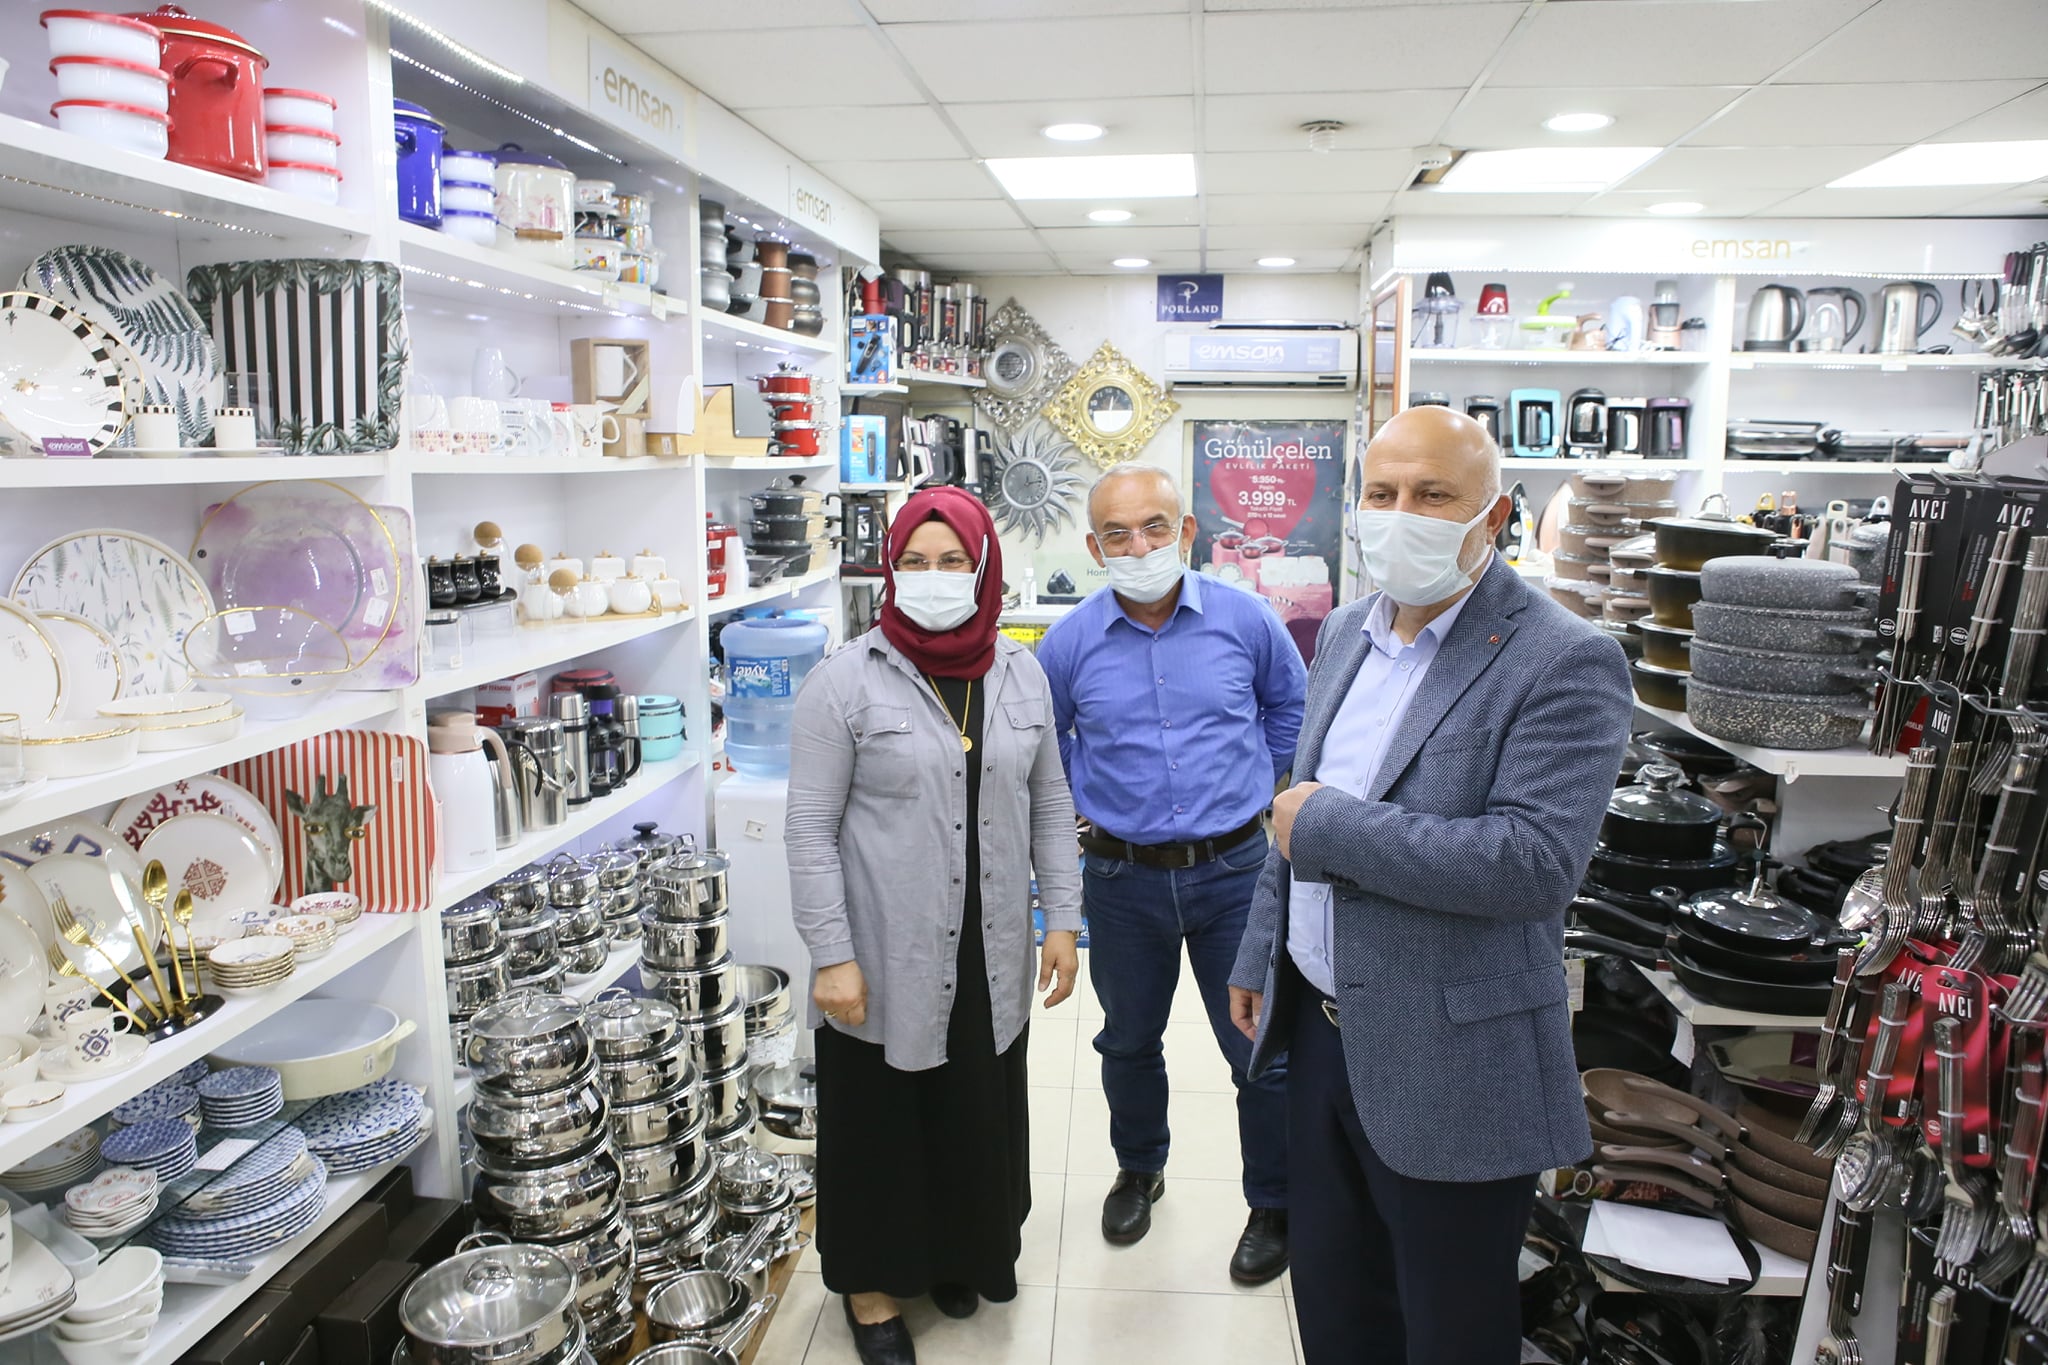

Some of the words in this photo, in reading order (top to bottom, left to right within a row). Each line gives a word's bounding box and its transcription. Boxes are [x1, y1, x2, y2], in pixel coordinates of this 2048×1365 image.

[603, 66, 674, 133] emsan
[796, 187, 832, 226] emsan
[1691, 239, 1792, 259] emsan
[1161, 304, 1219, 314] PORLAND
[1198, 344, 1285, 361] emsan
[1204, 437, 1332, 464] Gönülçelen
[1238, 490, 1286, 506] 3.999
[1287, 498, 1297, 506] TL
[1909, 499, 1947, 520] AVCI
[1996, 503, 2034, 527] AVC
[1931, 709, 1951, 735] AVCI
[1897, 968, 1924, 995] AVC
[1938, 992, 1972, 1019] AVCI
[1933, 1258, 1975, 1290] AVCI
